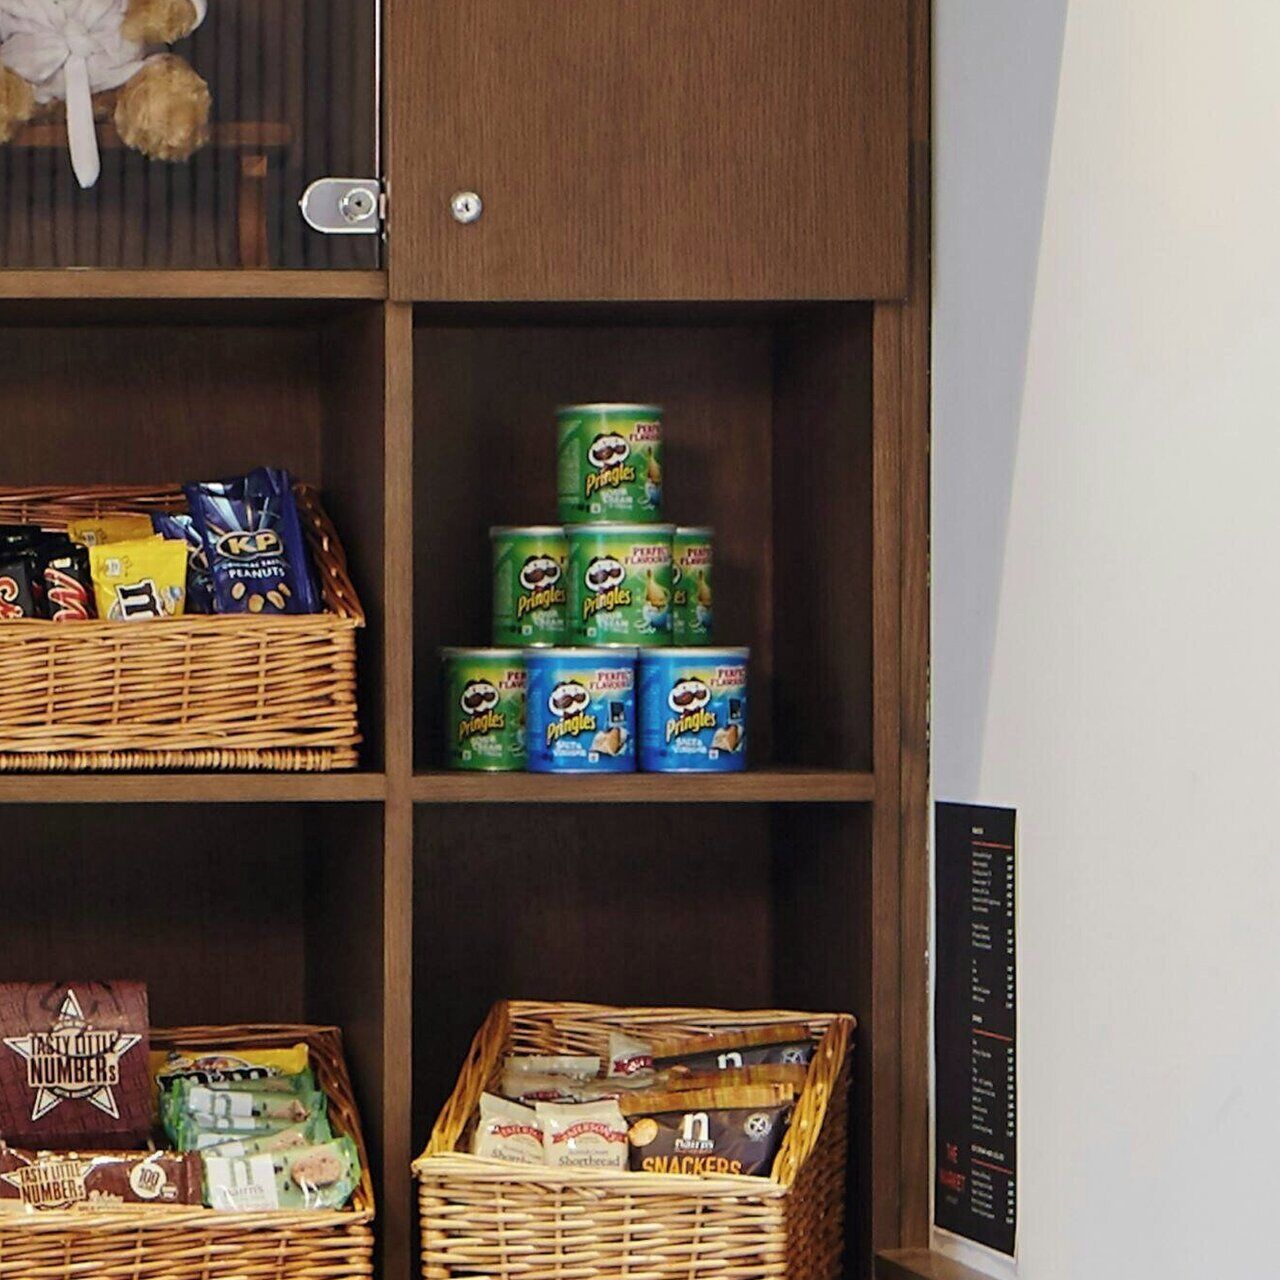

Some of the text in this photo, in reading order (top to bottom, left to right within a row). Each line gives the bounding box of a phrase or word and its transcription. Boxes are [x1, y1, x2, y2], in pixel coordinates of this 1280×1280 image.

[585, 463, 635, 497] Pringles
[228, 533, 277, 554] KP
[228, 566, 285, 579] PEANUTS
[518, 587, 566, 618] Pringles
[584, 586, 631, 618] Pringles
[458, 709, 505, 741] Pringles
[547, 712, 596, 746] Pringles
[666, 707, 716, 743] Pringles
[30, 1033, 116, 1055] TASTY LITTLE
[682, 1111, 710, 1140] n
